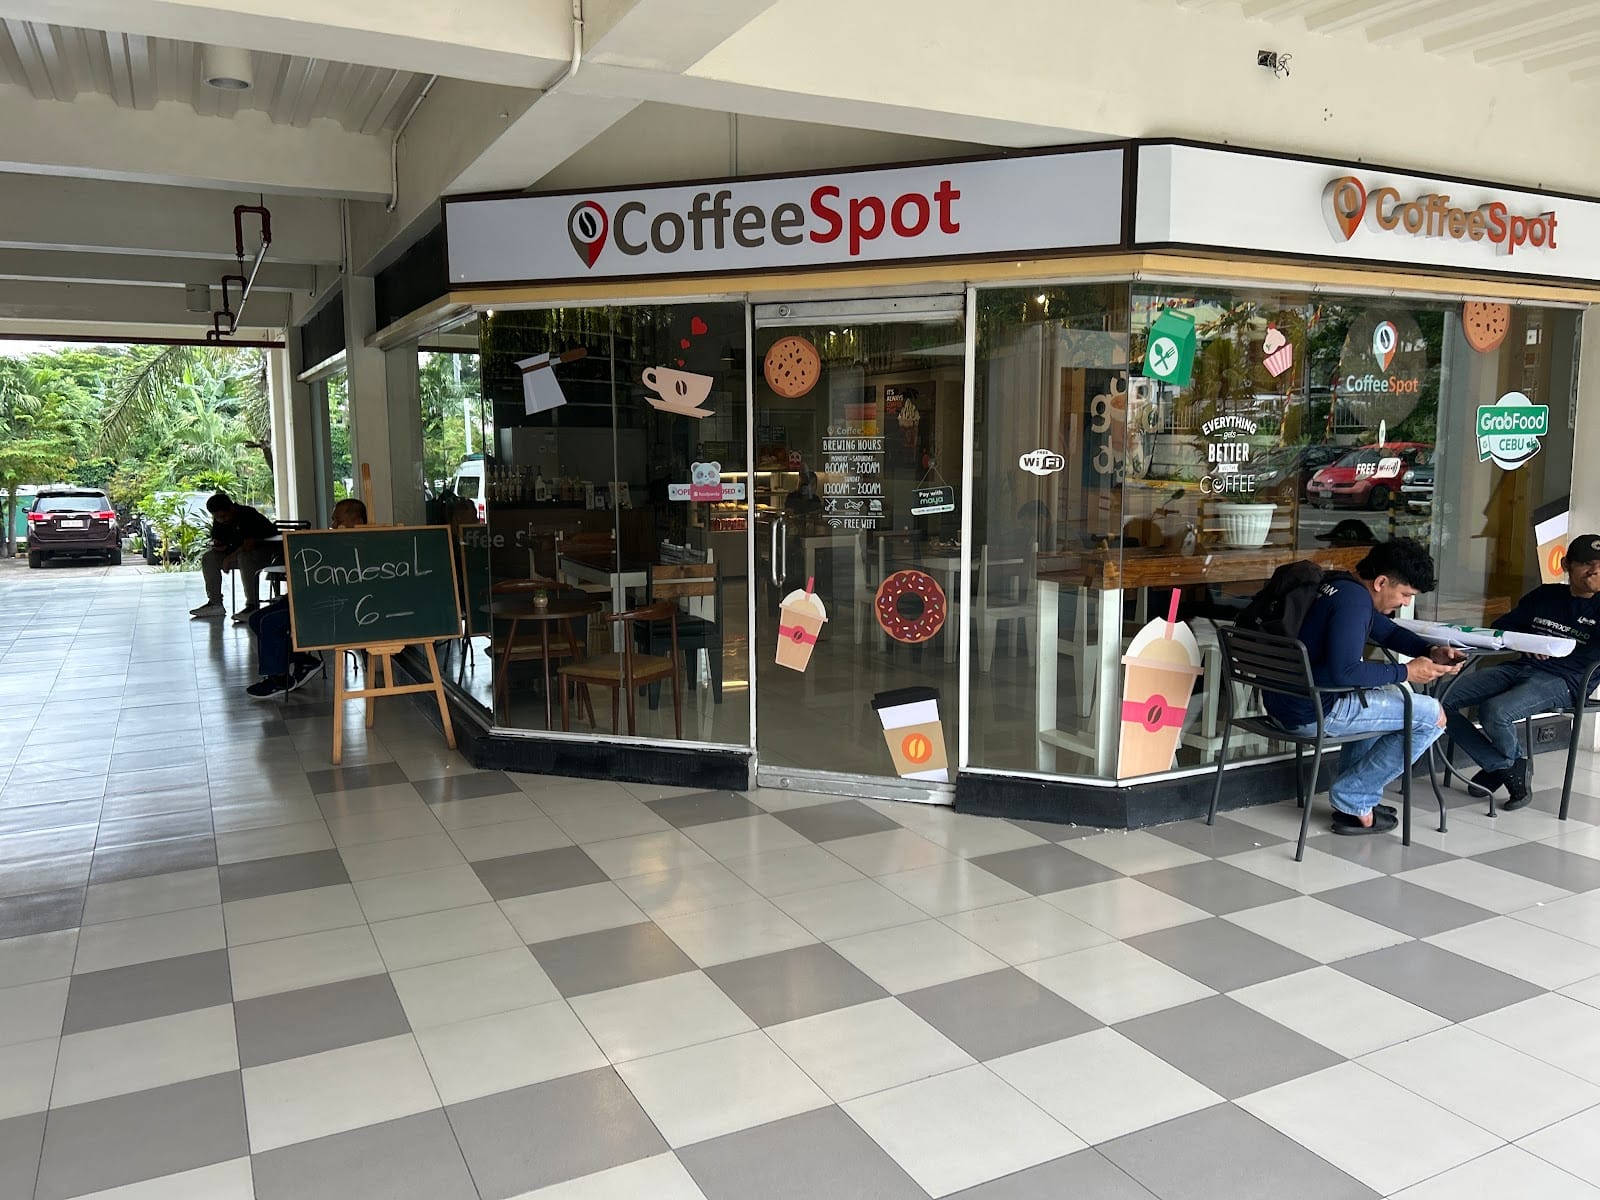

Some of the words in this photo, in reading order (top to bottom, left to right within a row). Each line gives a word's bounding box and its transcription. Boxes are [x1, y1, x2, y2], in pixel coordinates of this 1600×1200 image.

[613, 180, 961, 256] CoffeeSpot
[1374, 186, 1558, 255] CoffeeSpot
[1346, 374, 1419, 396] CoffeeSpot
[1201, 415, 1257, 436] EVERYTHING
[1480, 411, 1545, 431] GrabFood
[823, 439, 857, 451] BREWING
[857, 439, 882, 451] HOURS
[1223, 430, 1237, 440] gets
[1498, 438, 1525, 451] CEBU
[1208, 442, 1250, 463] BETTER
[1355, 462, 1377, 475] FREE
[1200, 474, 1256, 494] COFFEE
[918, 491, 930, 499] Pay
[920, 496, 944, 505] maya
[843, 518, 860, 529] FREE
[861, 518, 876, 529] WIFI
[464, 529, 505, 549] ffee
